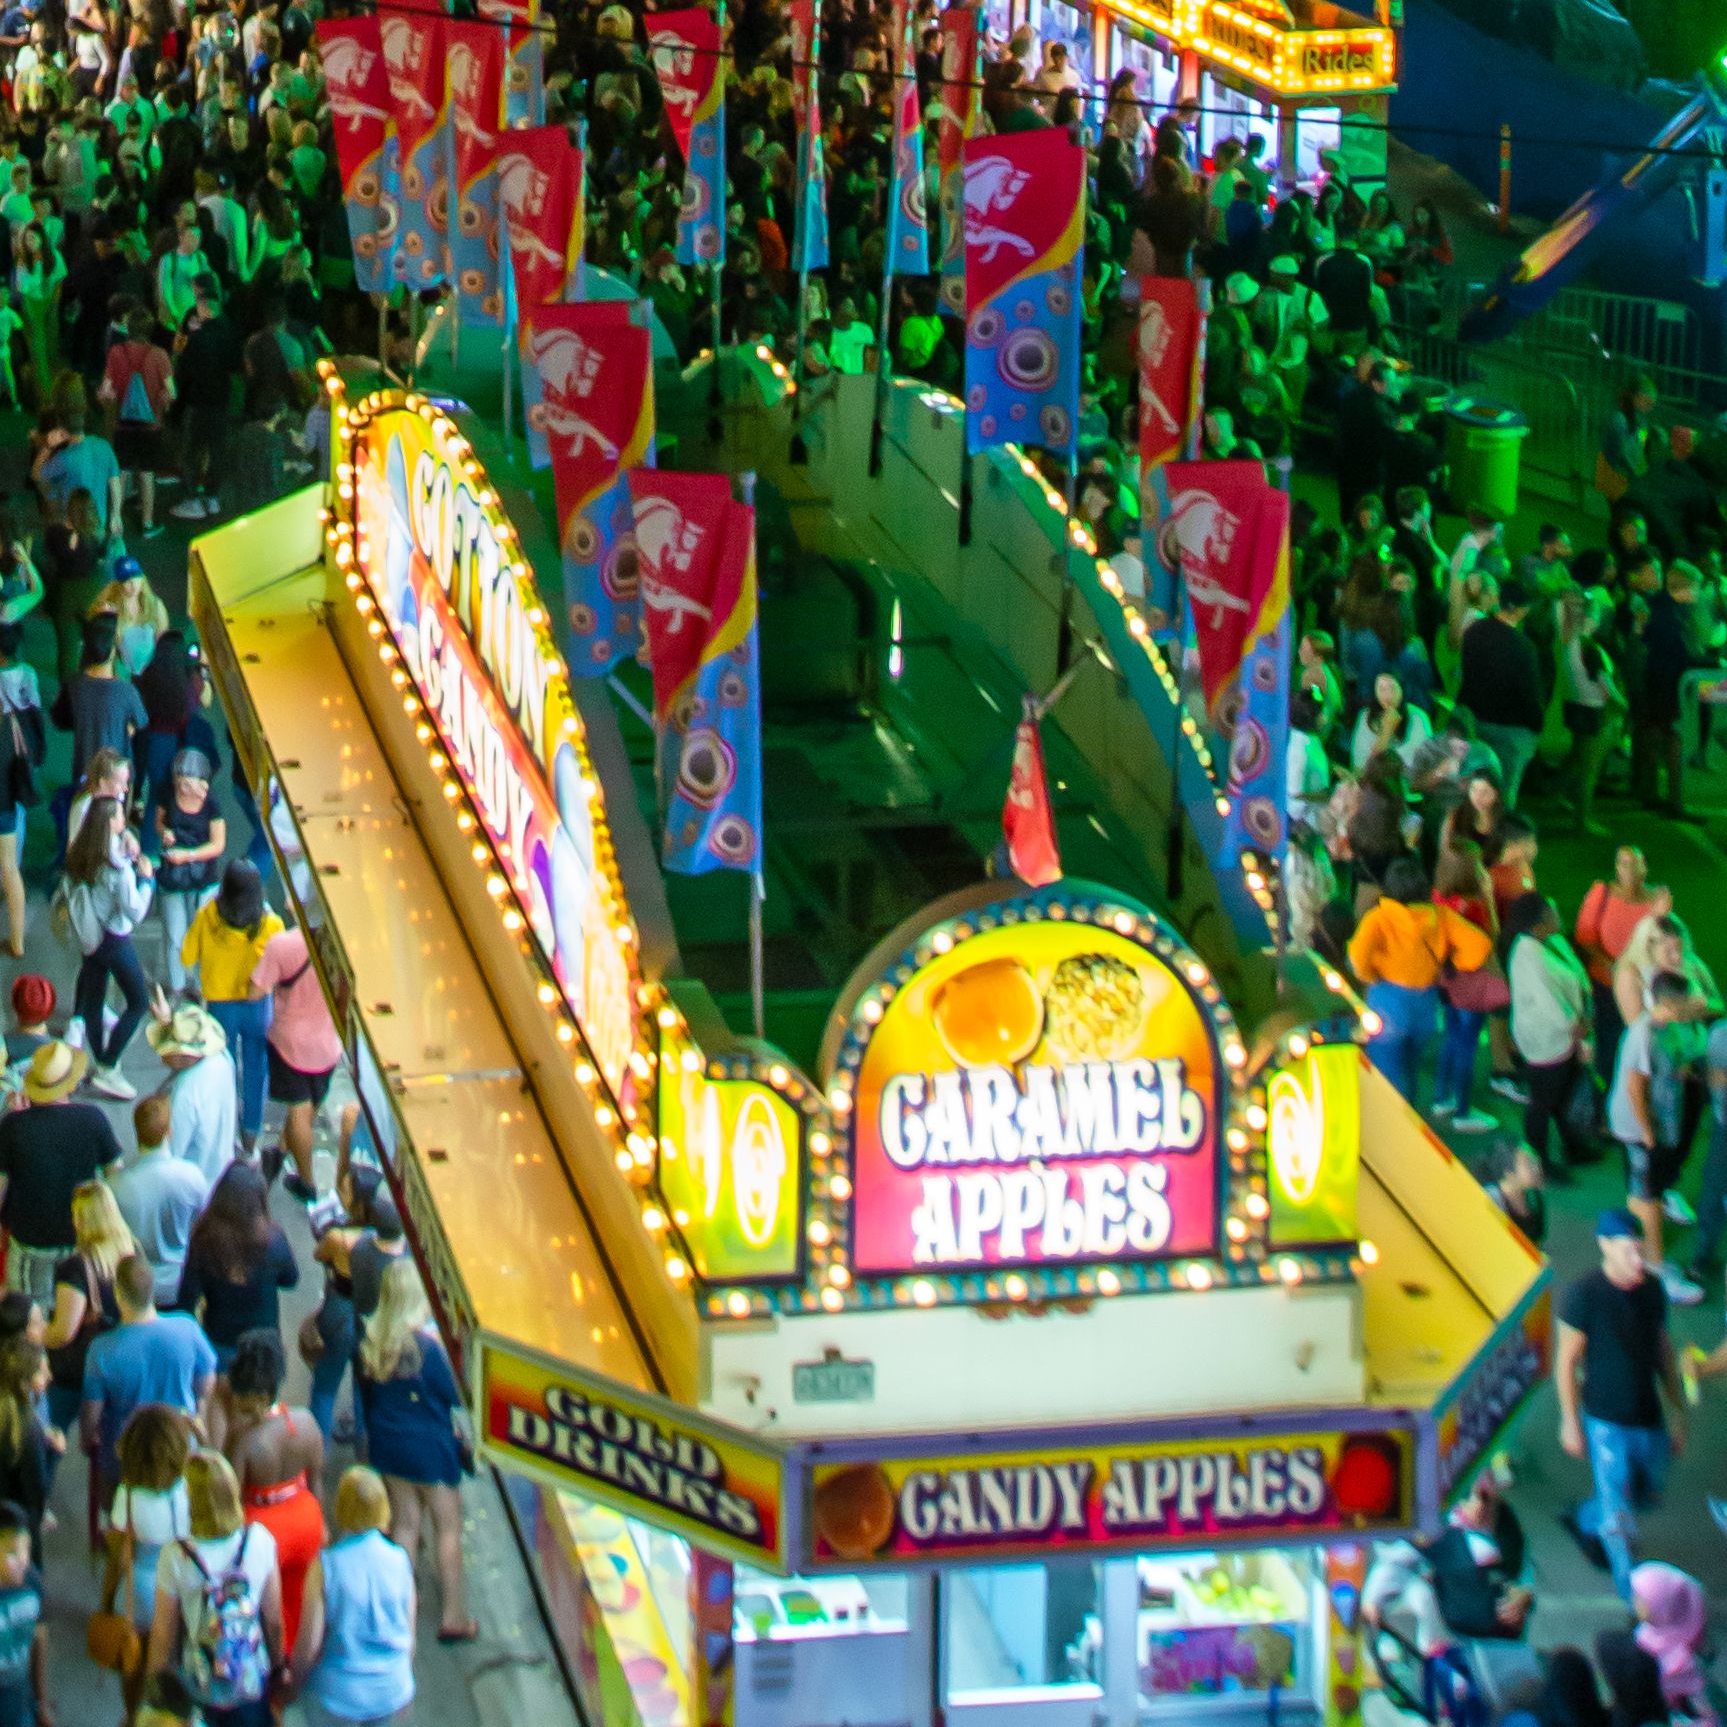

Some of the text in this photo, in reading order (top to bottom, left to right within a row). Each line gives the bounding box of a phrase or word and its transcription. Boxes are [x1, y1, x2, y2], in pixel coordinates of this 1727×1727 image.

[1303, 47, 1373, 75] Rides
[414, 448, 548, 763] COTTON
[419, 604, 533, 881] CANDY
[880, 1057, 1205, 1167] CARAMEL
[911, 1161, 1171, 1263] APPLES
[508, 1403, 762, 1536] DRINKS
[544, 1386, 721, 1480] COLD
[900, 1448, 1325, 1539] CANDY APPLES
